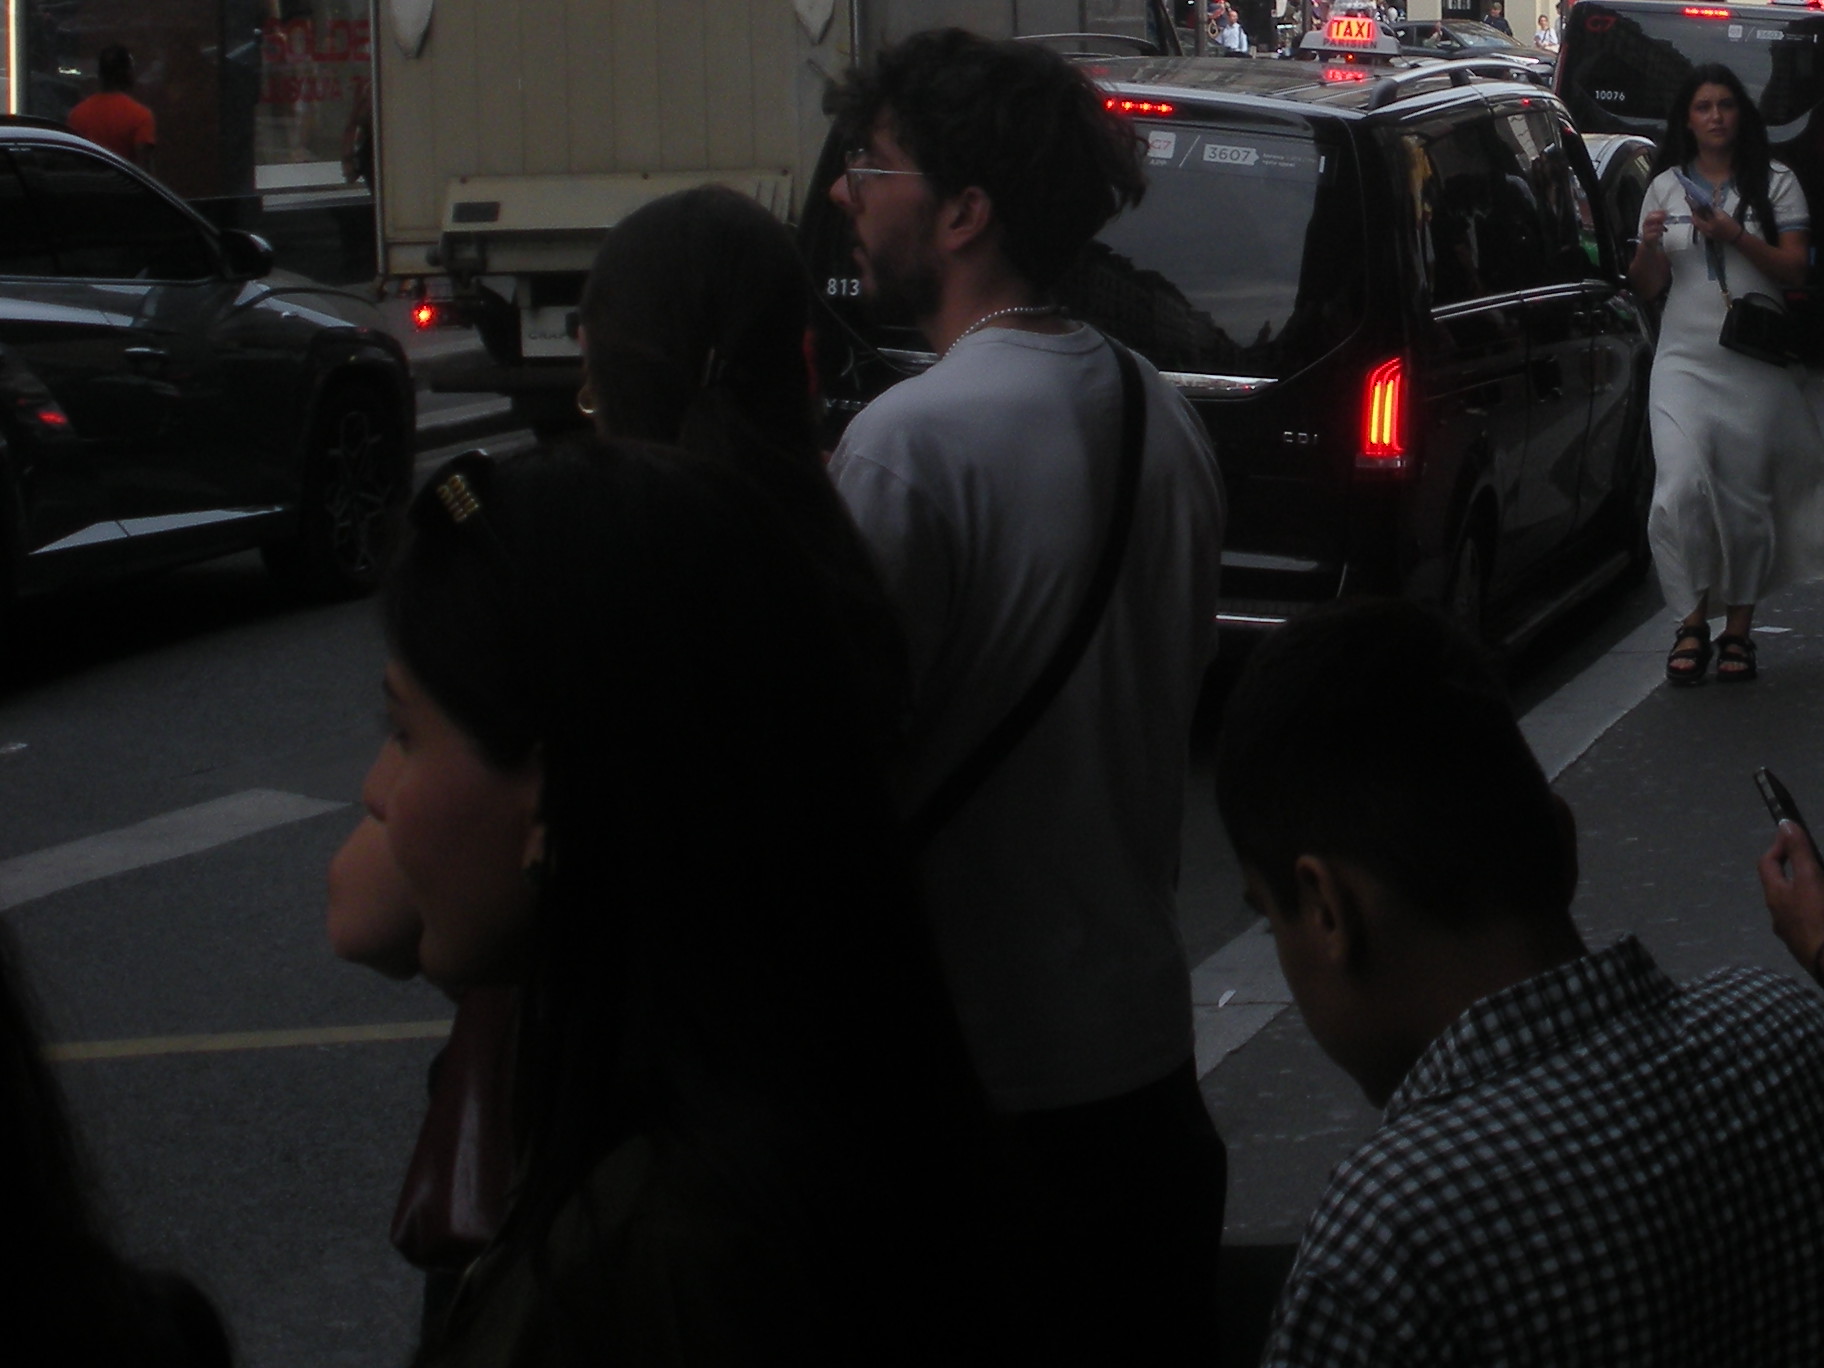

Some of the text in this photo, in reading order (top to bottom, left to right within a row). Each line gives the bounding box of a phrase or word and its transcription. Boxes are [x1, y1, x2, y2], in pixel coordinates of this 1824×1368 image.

[1333, 18, 1374, 40] TAXI
[263, 17, 370, 63] SOLDE
[1323, 39, 1377, 49] PARISIEN
[1594, 89, 1626, 102] 10076
[1208, 146, 1251, 161] 3607
